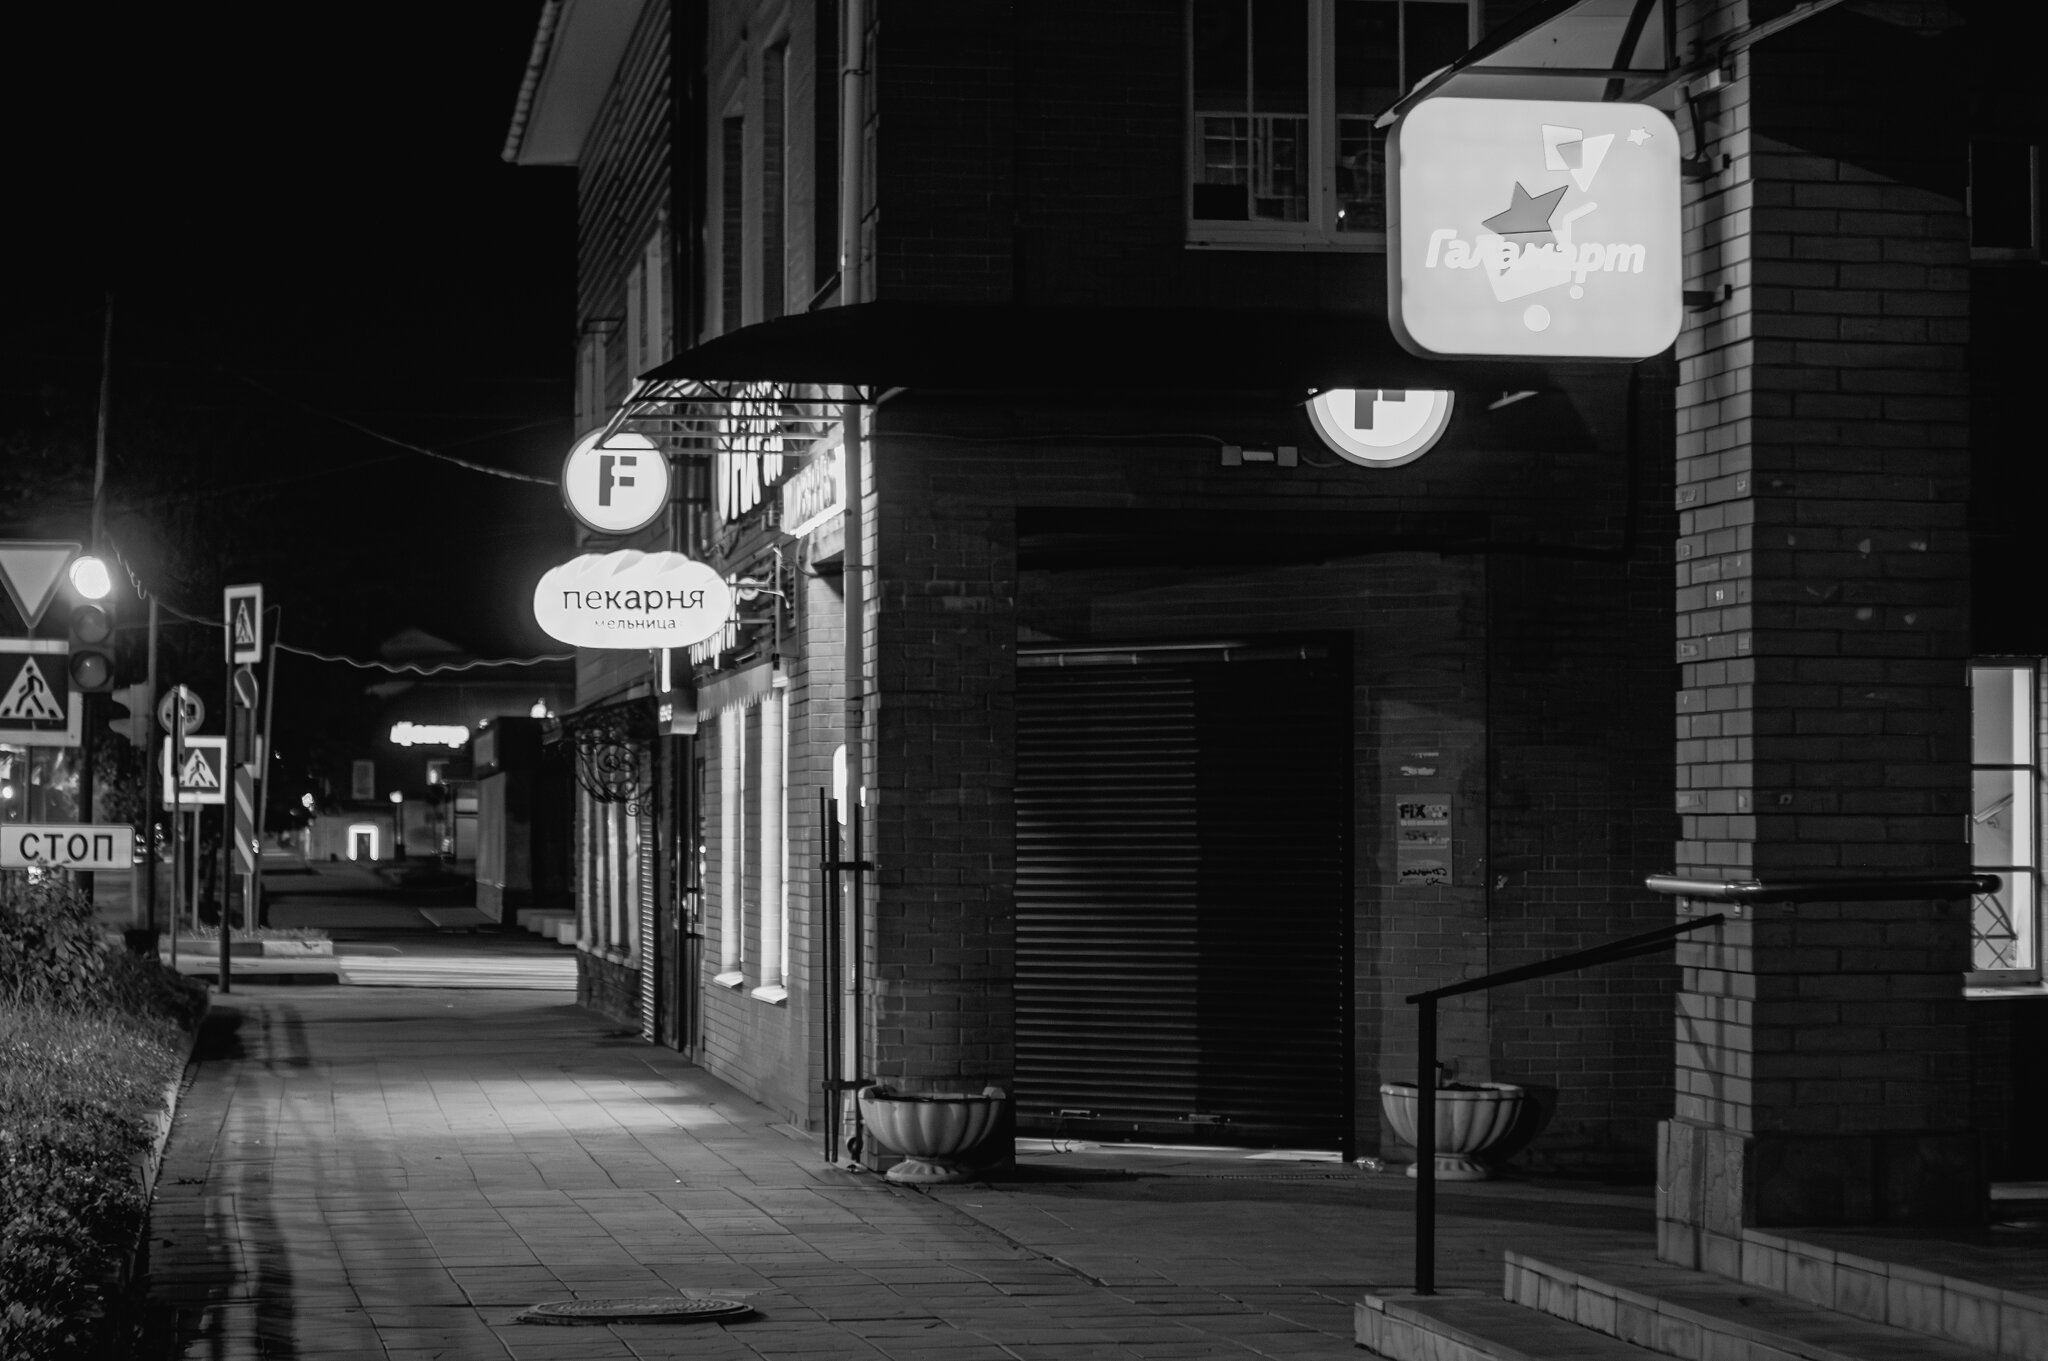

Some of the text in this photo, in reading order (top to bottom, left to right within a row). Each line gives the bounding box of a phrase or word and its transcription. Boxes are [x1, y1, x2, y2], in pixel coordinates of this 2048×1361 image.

[598, 455, 638, 506] F
[562, 589, 705, 615] пекарня
[20, 833, 113, 861] СТОП
